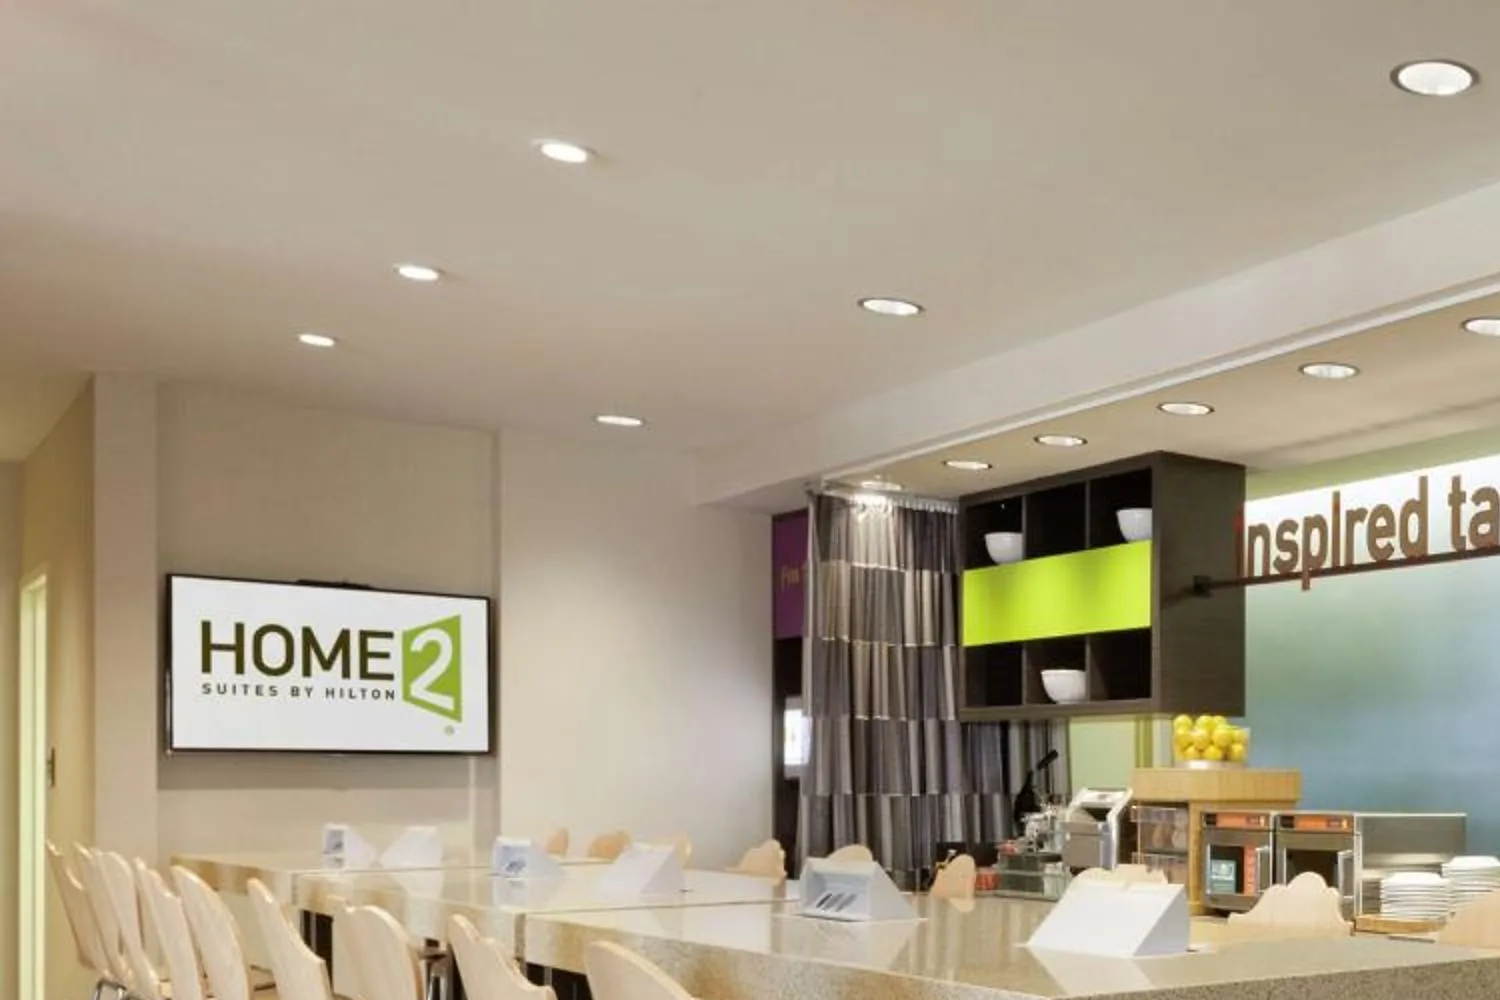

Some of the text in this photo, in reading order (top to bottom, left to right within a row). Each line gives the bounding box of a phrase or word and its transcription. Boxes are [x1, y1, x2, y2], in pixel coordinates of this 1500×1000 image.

[200, 620, 460, 718] HOME 2
[202, 683, 396, 701] SUITES BY HILTON
